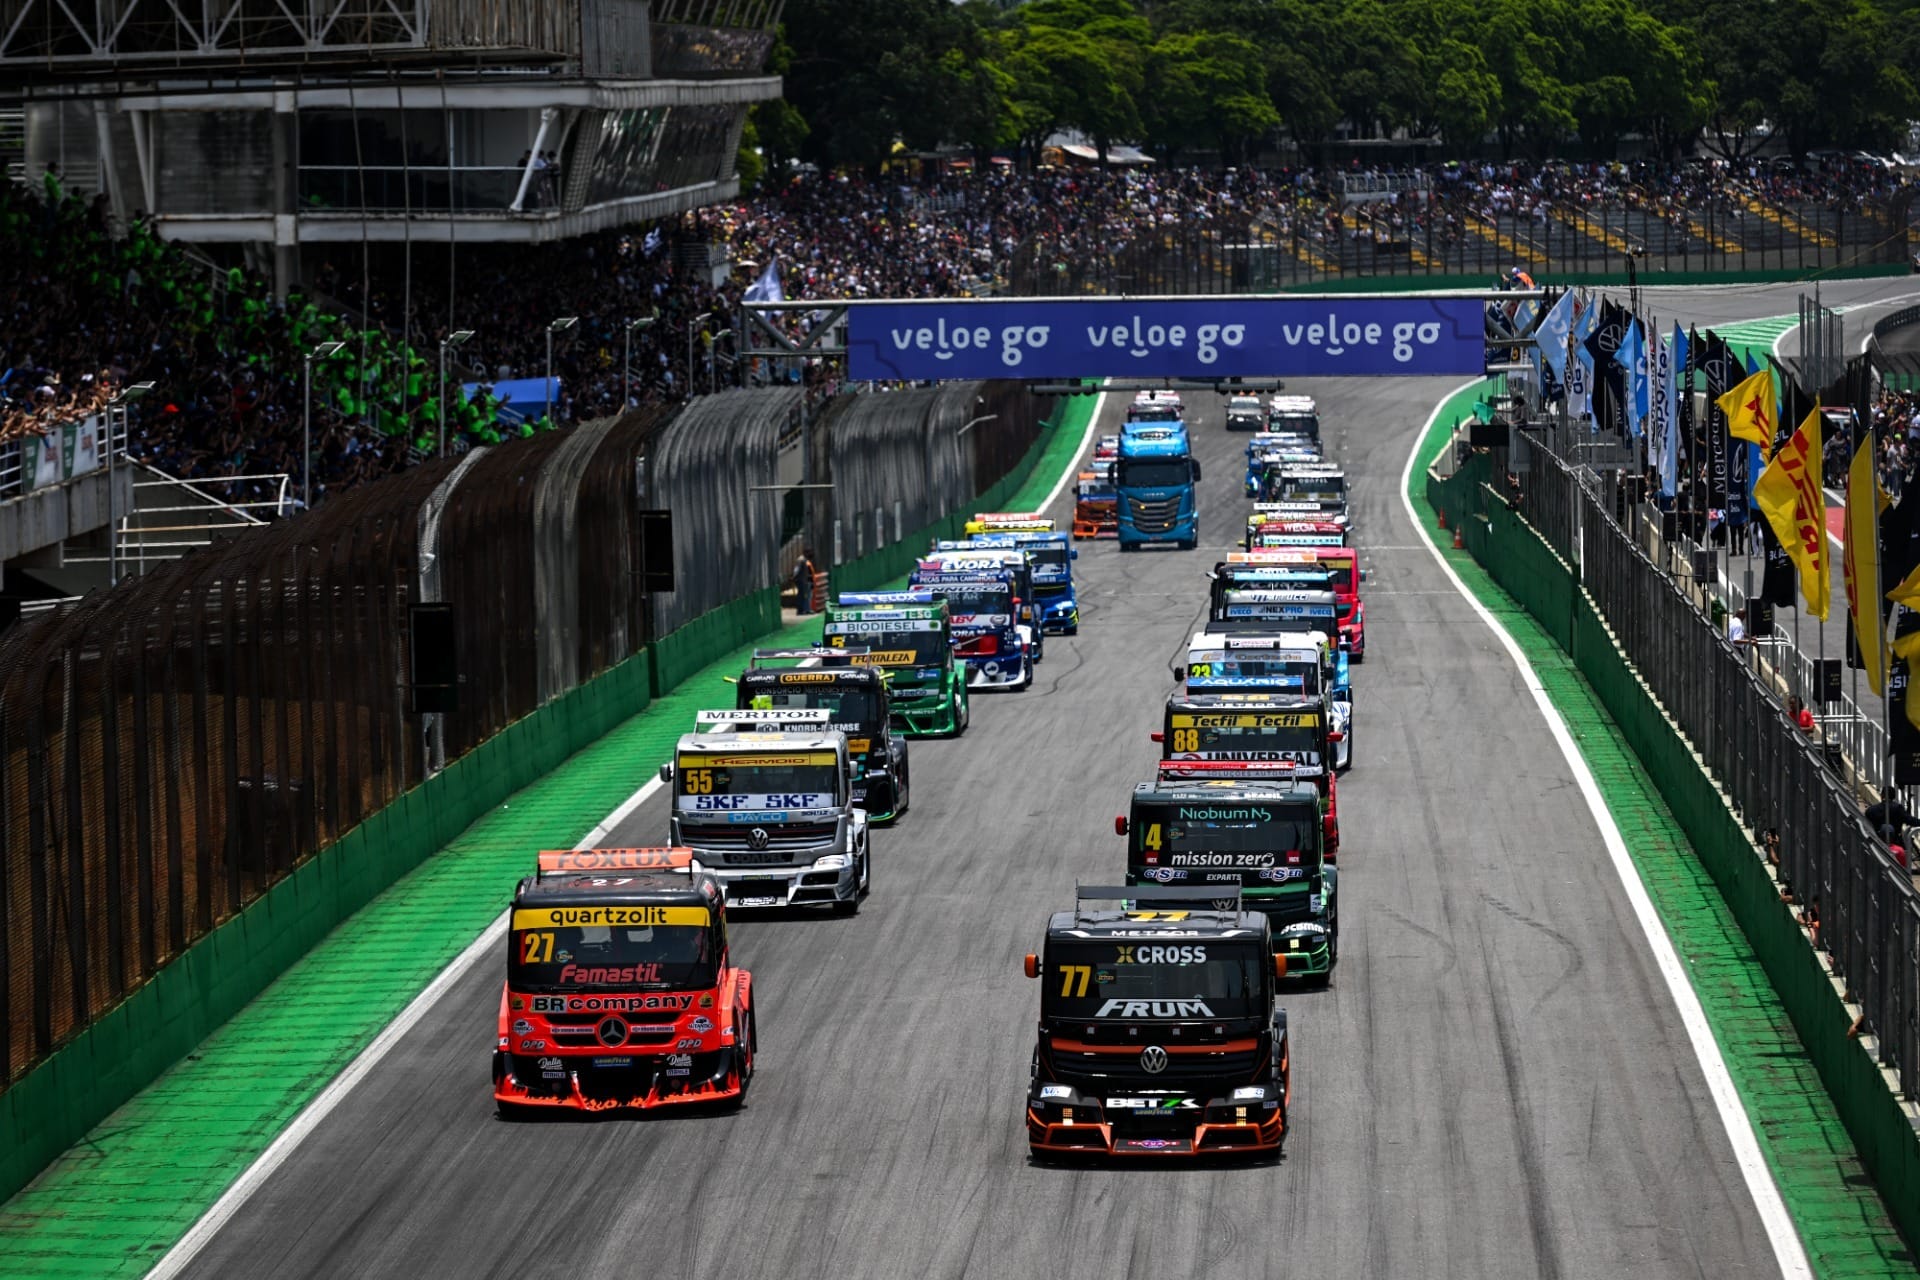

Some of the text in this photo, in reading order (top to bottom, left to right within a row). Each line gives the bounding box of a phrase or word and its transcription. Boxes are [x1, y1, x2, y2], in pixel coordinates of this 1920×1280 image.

[891, 318, 1050, 366] veloe go
[1087, 316, 1245, 364] veloe go
[1282, 313, 1441, 362] veloe go
[1284, 523, 1317, 533] WEGA
[941, 560, 1002, 570] EVORA
[909, 610, 933, 619] ESG
[1230, 605, 1333, 615] IVECO NEXPRO IVECO
[833, 612, 858, 621] ESG
[847, 622, 921, 632] BIODIESEL
[831, 636, 844, 648] 5
[784, 673, 831, 683] GUERRA
[704, 710, 820, 720] MERITOR
[1192, 715, 1301, 727] Tecfil Tecfil
[1173, 729, 1199, 753] 88
[710, 756, 808, 766] THERMOID
[1205, 751, 1315, 767] UNIVERSAL
[1254, 768, 1320, 776] AUTOMOIVAS
[686, 769, 713, 795] 55
[696, 794, 819, 810] SKF SKF
[733, 812, 783, 823] DAYCO
[1179, 807, 1249, 820] Niobium
[1145, 823, 1162, 851] 4
[557, 848, 673, 868] FOXLUX
[1171, 851, 1232, 866] mission
[1235, 853, 1275, 867] zero
[1144, 867, 1188, 882] CISER
[1206, 873, 1242, 881] EXPARTS
[1259, 867, 1303, 882] CISER
[592, 878, 633, 887] 27
[550, 907, 667, 926] quartzolit
[1126, 911, 1190, 922] 77
[525, 932, 556, 963] 27
[559, 963, 663, 984] Famastil
[1059, 965, 1092, 998] 77
[1094, 999, 1216, 1017] FRUM
[521, 1039, 546, 1050] DPD
[677, 1038, 703, 1049] DPD
